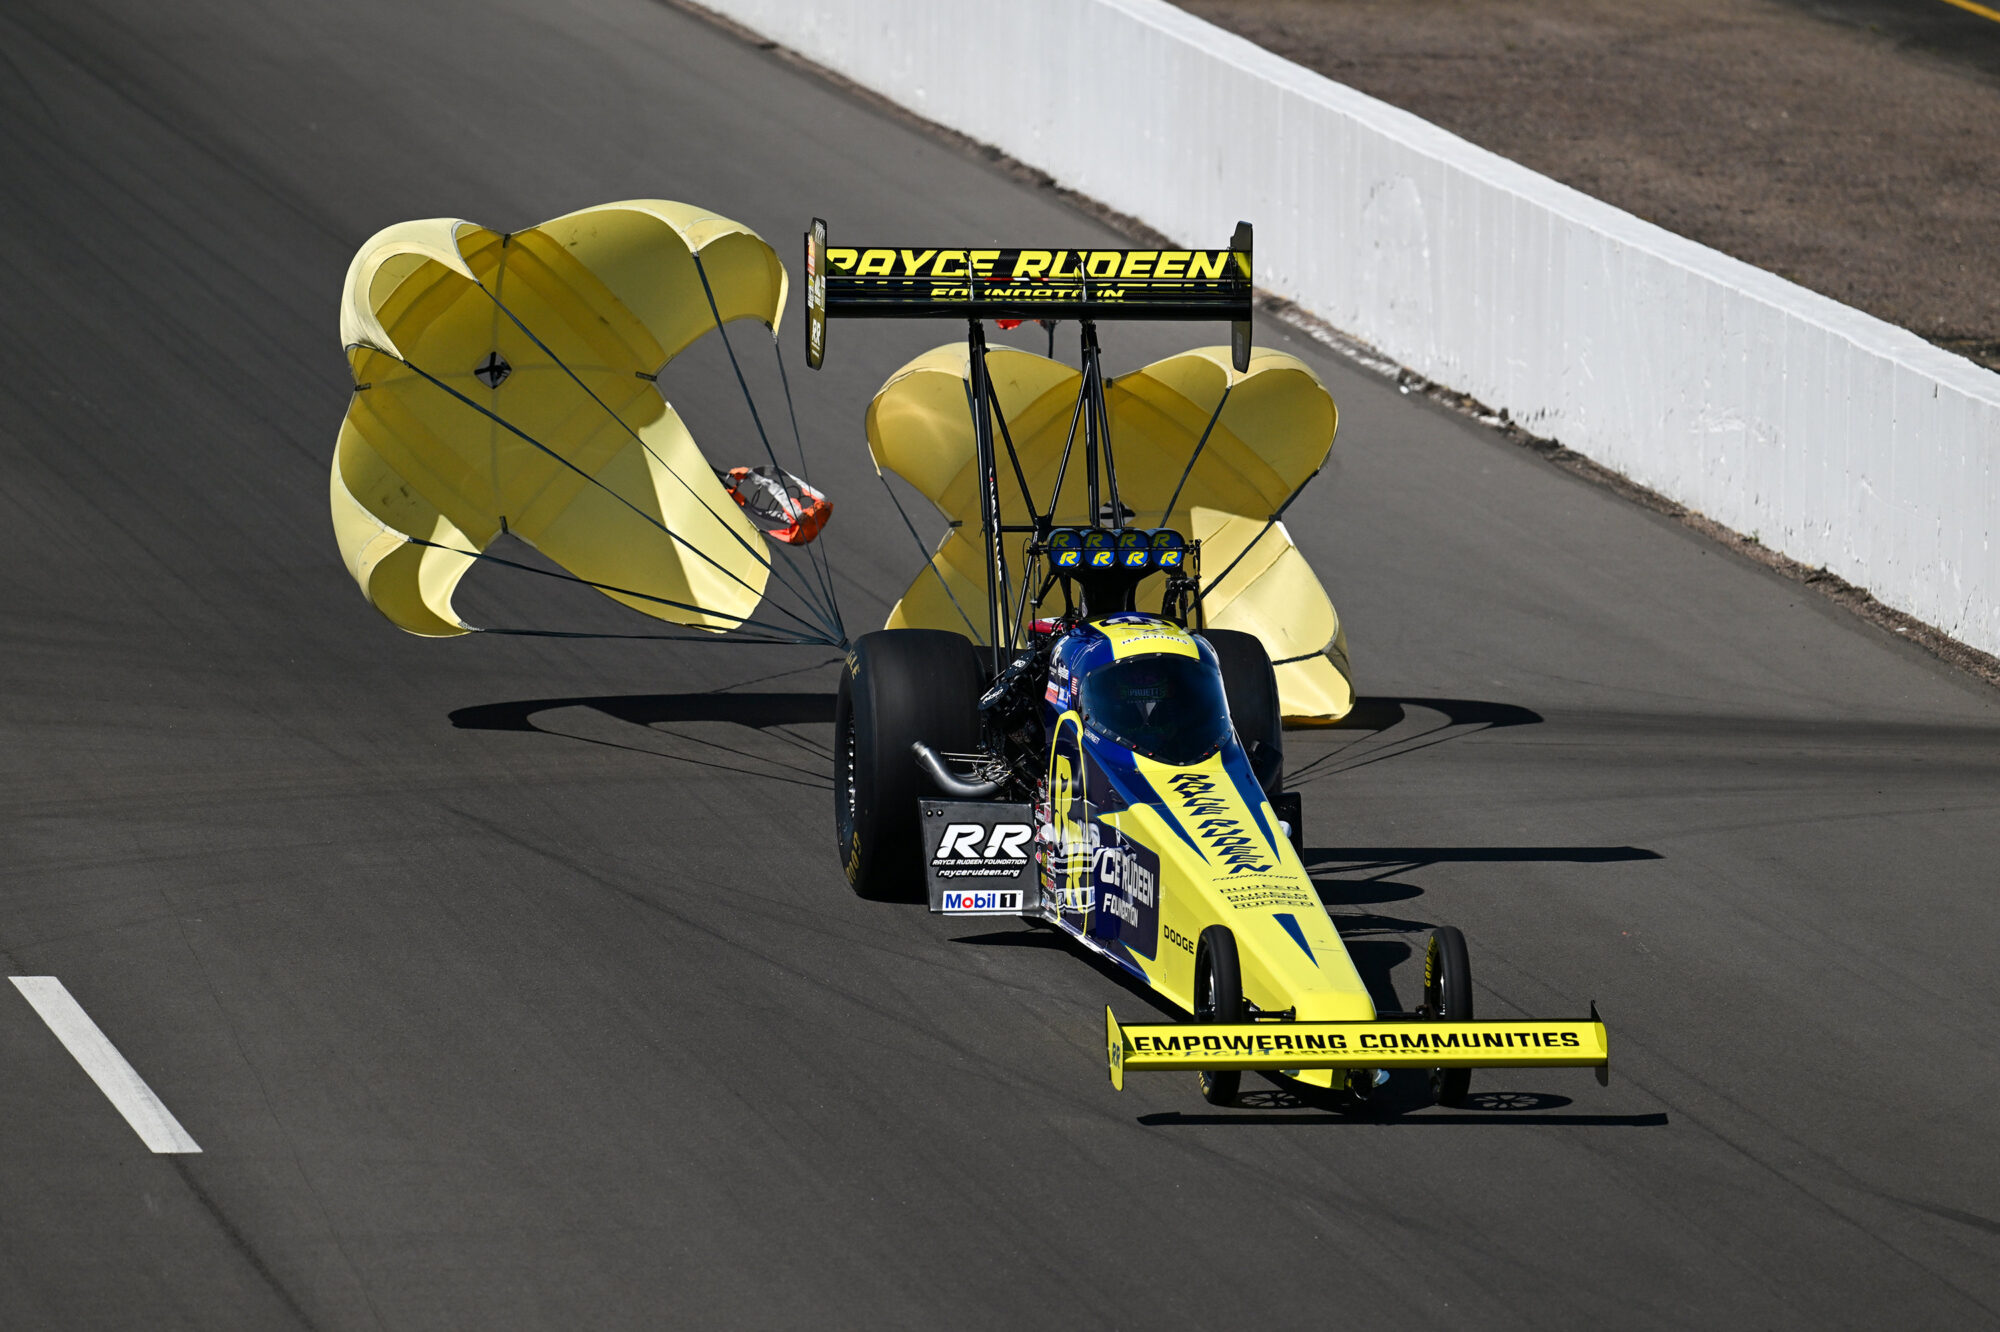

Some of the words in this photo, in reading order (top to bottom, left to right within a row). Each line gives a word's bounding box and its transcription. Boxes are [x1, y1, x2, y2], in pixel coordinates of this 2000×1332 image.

[1012, 251, 1229, 279] RUDEEN
[1060, 551, 1077, 565] R
[1093, 551, 1110, 565] R
[1127, 551, 1144, 565] R
[1160, 551, 1177, 565] R
[1167, 773, 1231, 816] RAYCE
[936, 824, 1032, 858] RR
[1197, 818, 1274, 874] RUDEEN
[938, 868, 1020, 878] raycerudeen.org
[945, 893, 996, 908] Mobil
[1163, 924, 1195, 955] DODGE
[1134, 1034, 1347, 1051] EMPOWERING
[1359, 1032, 1580, 1049] COMMUNITIES
